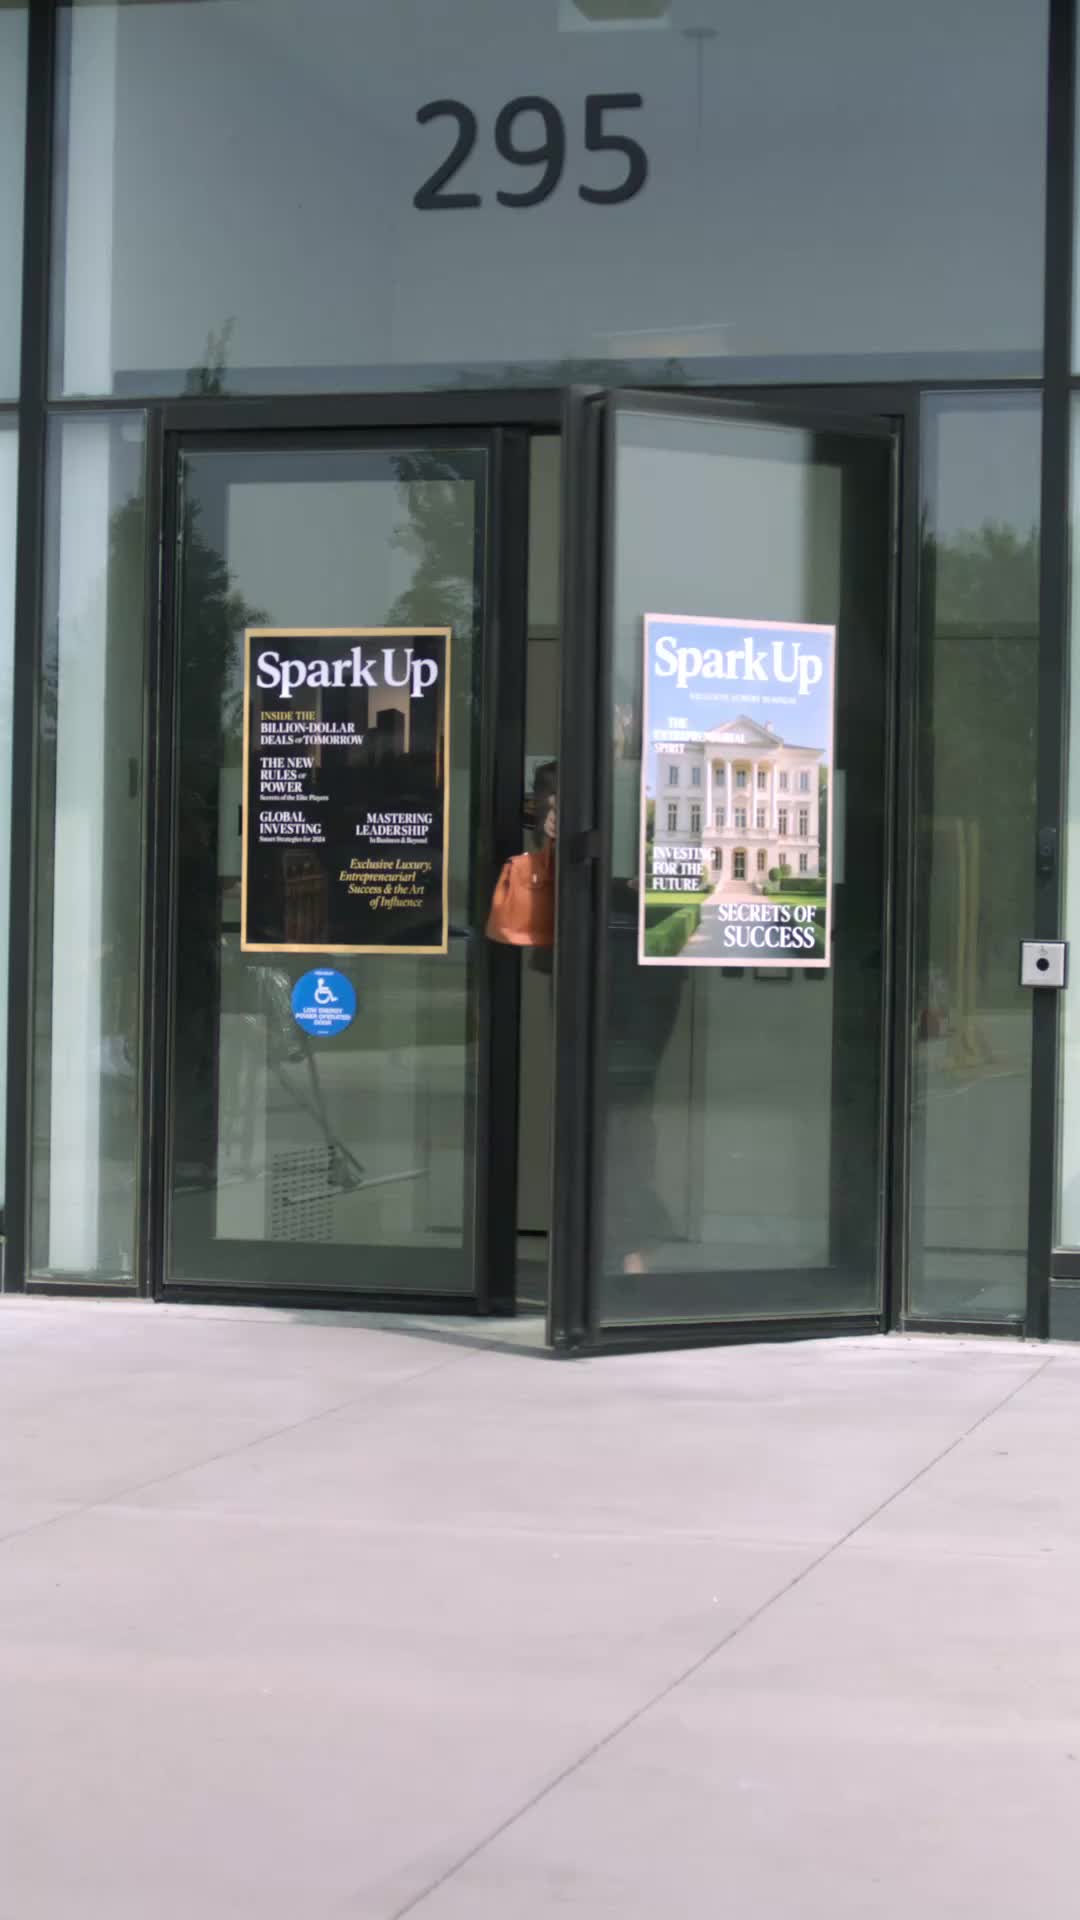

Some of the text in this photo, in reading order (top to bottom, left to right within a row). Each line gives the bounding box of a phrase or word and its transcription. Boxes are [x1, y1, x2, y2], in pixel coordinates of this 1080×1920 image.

[413, 93, 648, 210] 295
[656, 636, 823, 695] Spark Up
[256, 646, 438, 698] Spark Up
[261, 711, 316, 720] INSIDE THE
[260, 722, 356, 733] BILLION-DOLLAR
[260, 734, 294, 745] DEALS
[302, 735, 364, 745] TOMORROW
[260, 757, 314, 768] THE NEW
[260, 769, 297, 780] RULES
[260, 782, 302, 792] POWER
[260, 811, 305, 822] GLOBAL
[367, 813, 432, 824] MASTERING
[260, 823, 322, 834] INVESTING
[356, 825, 429, 836] LEADERSHIP
[653, 847, 716, 860] INVESTING
[350, 858, 432, 873] Exclusive Luxury,
[653, 862, 704, 876] FOR THE
[348, 883, 424, 895] Success & the Art
[653, 877, 700, 891] FUTURE
[369, 896, 381, 910] of
[718, 903, 817, 923] SECRETS OF
[723, 925, 815, 948] SUCCESS
